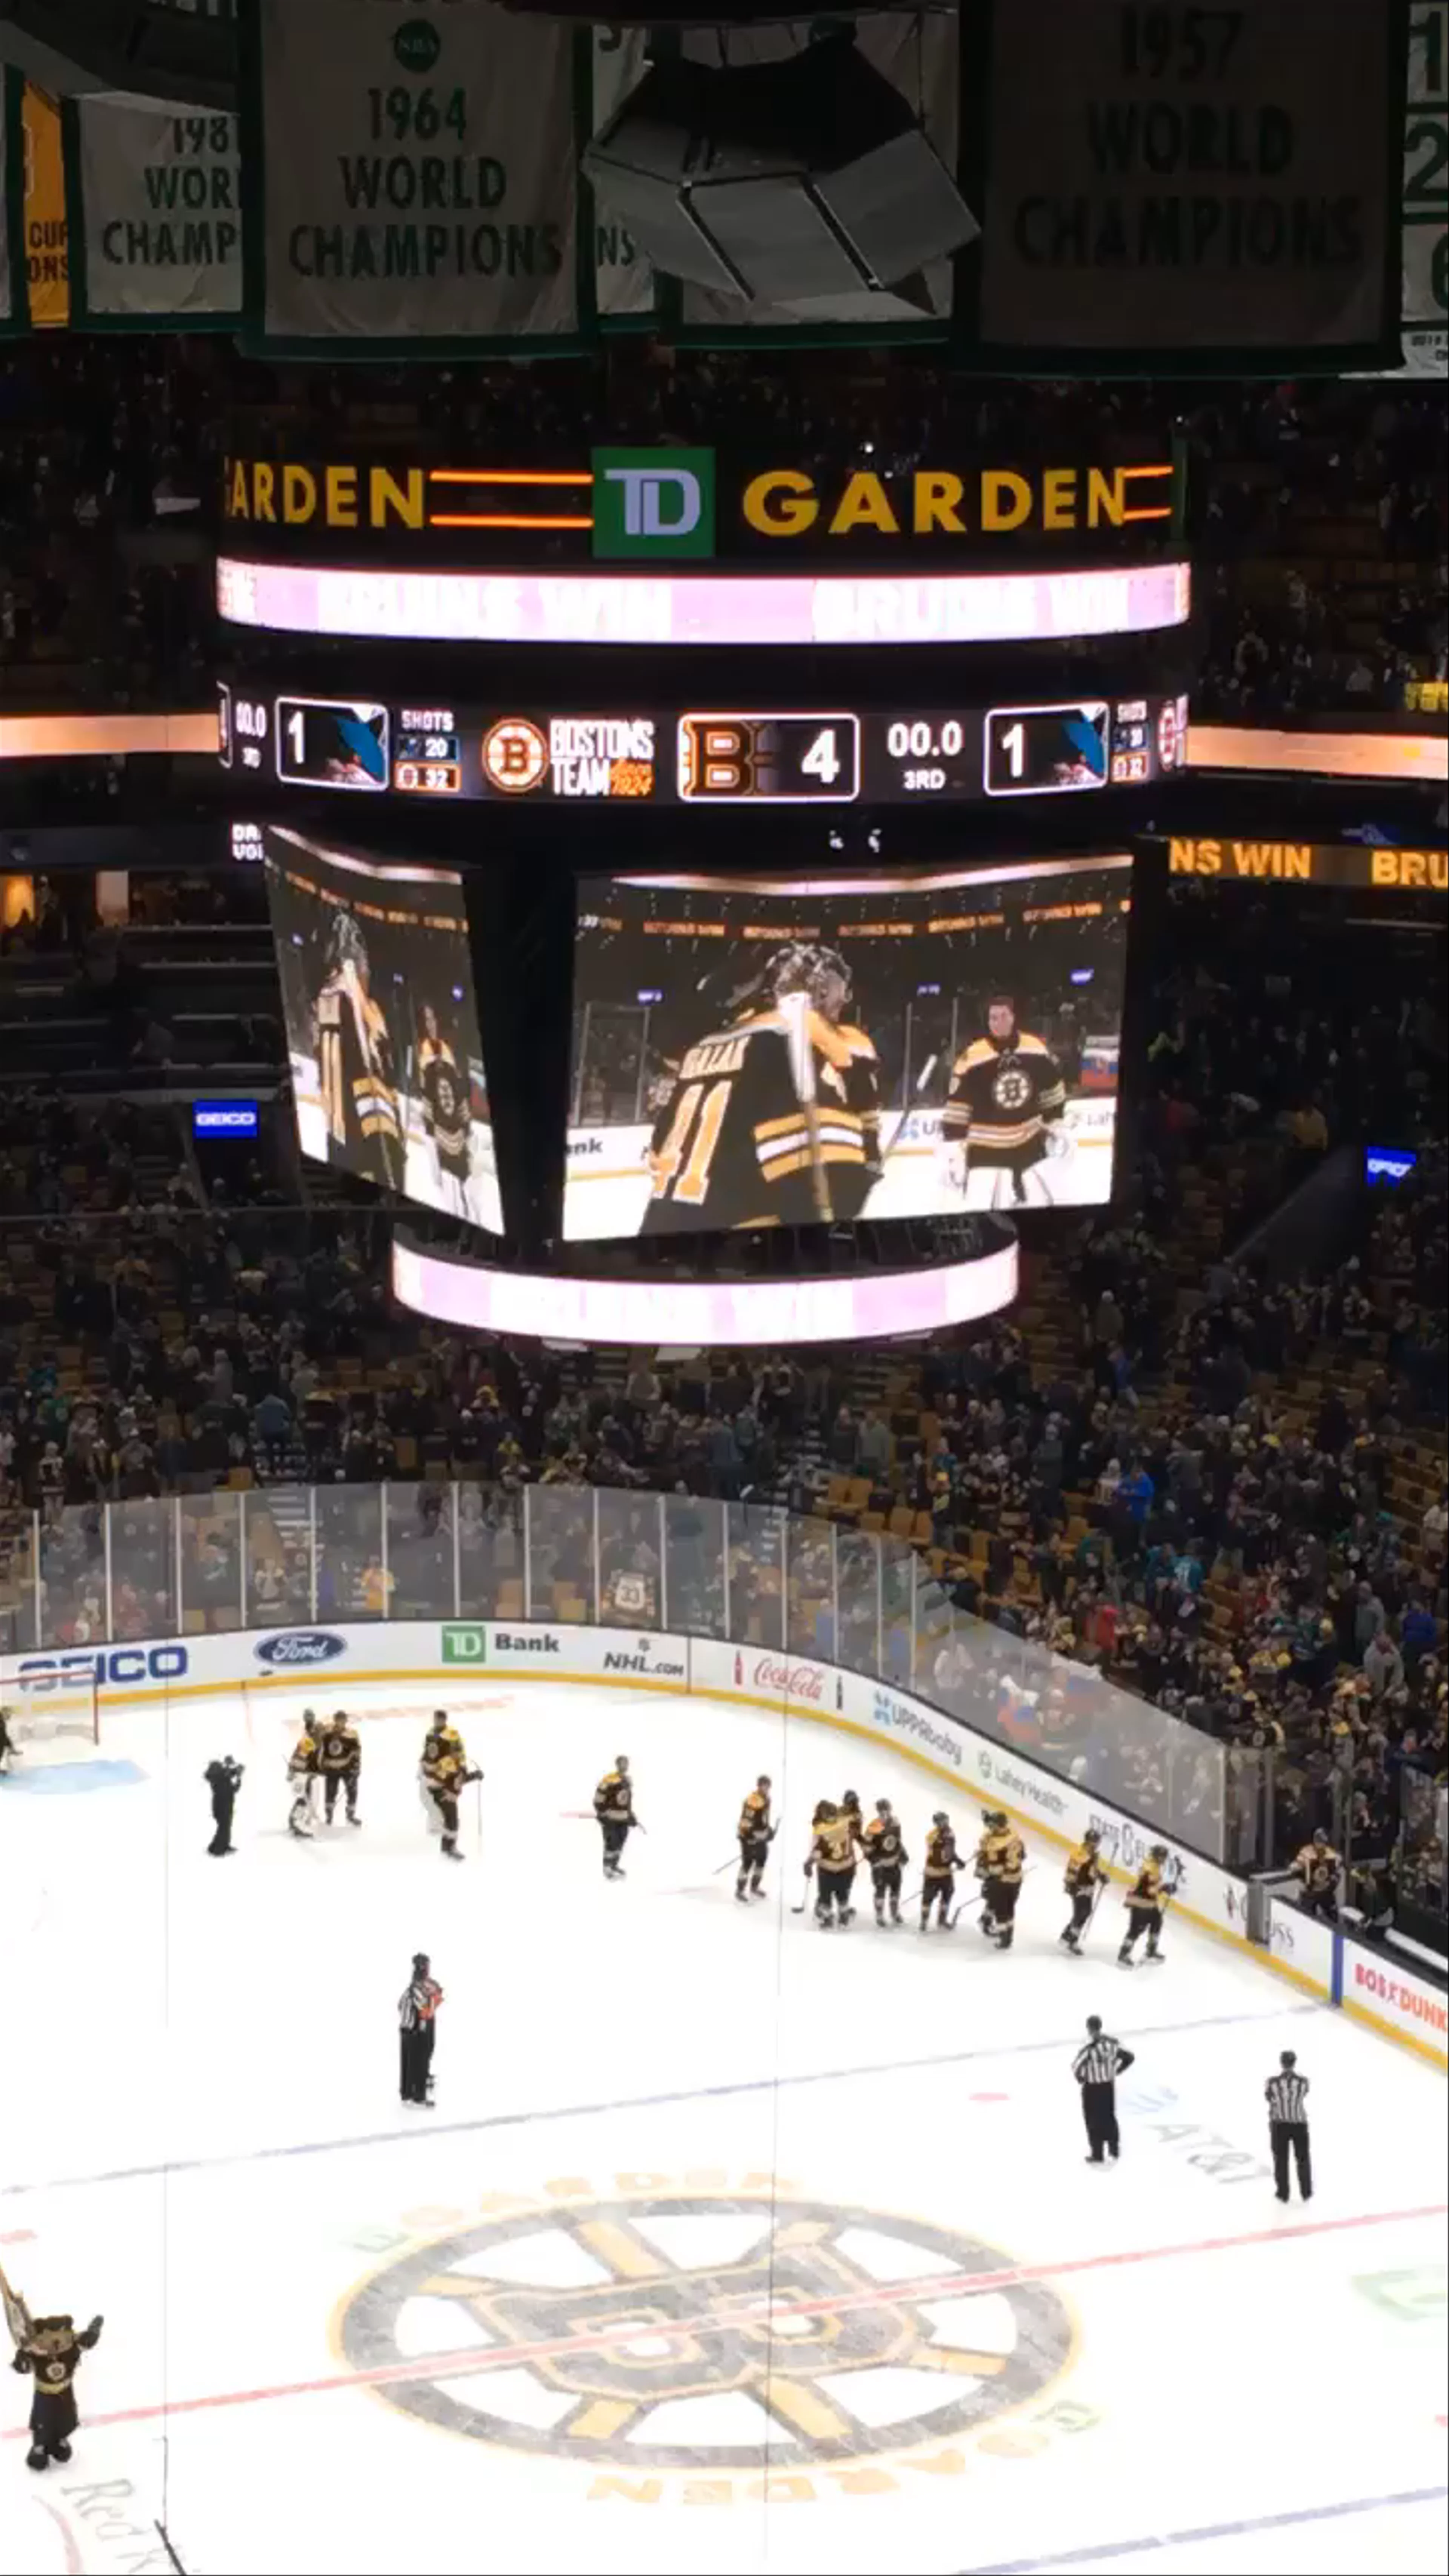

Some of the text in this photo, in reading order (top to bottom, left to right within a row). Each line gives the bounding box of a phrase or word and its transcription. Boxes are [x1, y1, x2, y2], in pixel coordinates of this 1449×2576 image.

[1121, 7, 1244, 79] 1957
[172, 117, 231, 153] 198
[368, 87, 467, 140] 1964
[1087, 100, 1294, 175] WORLD
[144, 166, 242, 209] WOR
[337, 155, 508, 209] WORLD
[288, 223, 562, 277] CHAMPIONS
[1013, 195, 1364, 269] CHAMPIONS
[226, 461, 424, 528] ARDEN
[605, 467, 1125, 536] TD GARDEN
[288, 711, 304, 764] 1
[401, 709, 455, 732] SHOTS
[887, 721, 963, 756] 00.0
[425, 738, 448, 758] 20
[801, 731, 840, 784] 4
[1001, 724, 1024, 777] 1
[551, 758, 611, 796] TEAM
[903, 770, 946, 791] 3RD
[1232, 842, 1311, 878] WIN
[19, 1645, 188, 1693] GEICO
[446, 1632, 560, 1657] TD Bank
